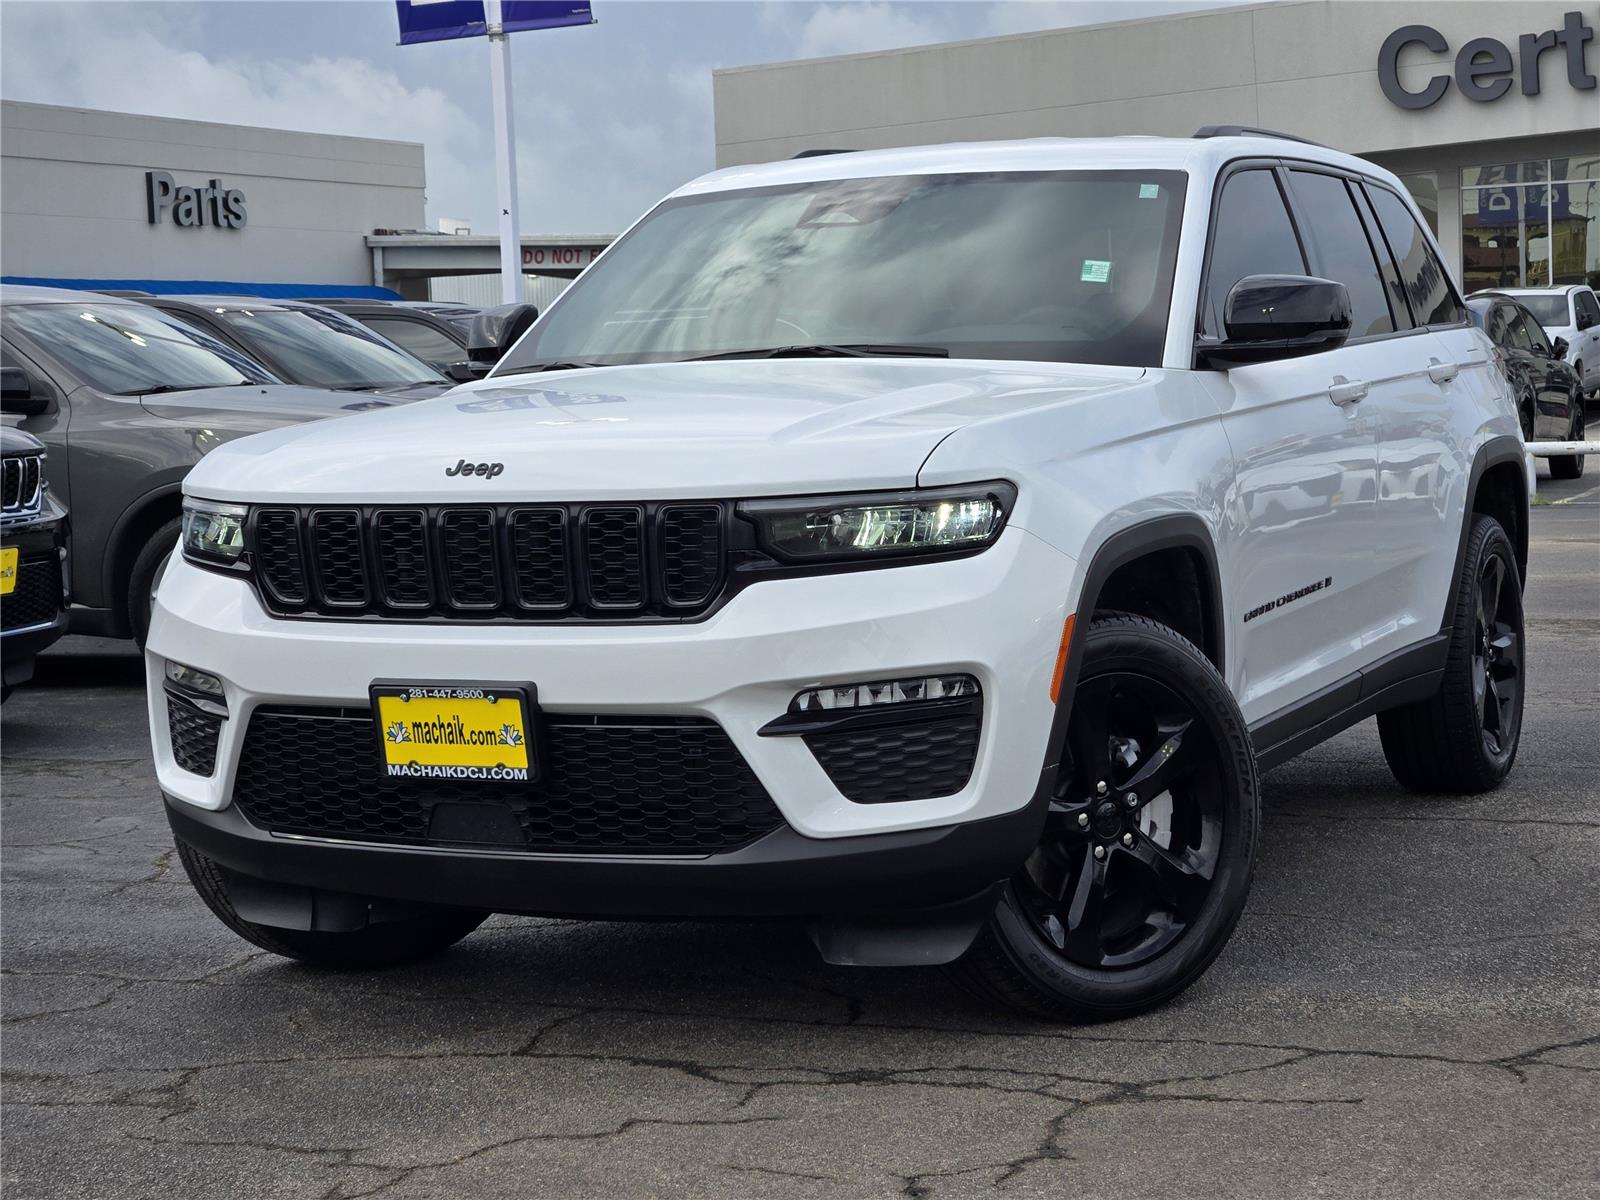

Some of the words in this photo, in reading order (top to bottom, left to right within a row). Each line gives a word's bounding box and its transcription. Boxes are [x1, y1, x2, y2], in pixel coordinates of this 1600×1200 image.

[145, 171, 247, 229] Parts
[523, 249, 545, 264] DO
[552, 248, 583, 264] NOT
[445, 459, 504, 480] Jeep
[408, 688, 484, 699] 281-447-9500
[411, 714, 498, 746] machaik.com
[387, 764, 528, 781] MACHAIKDCJ.COM
